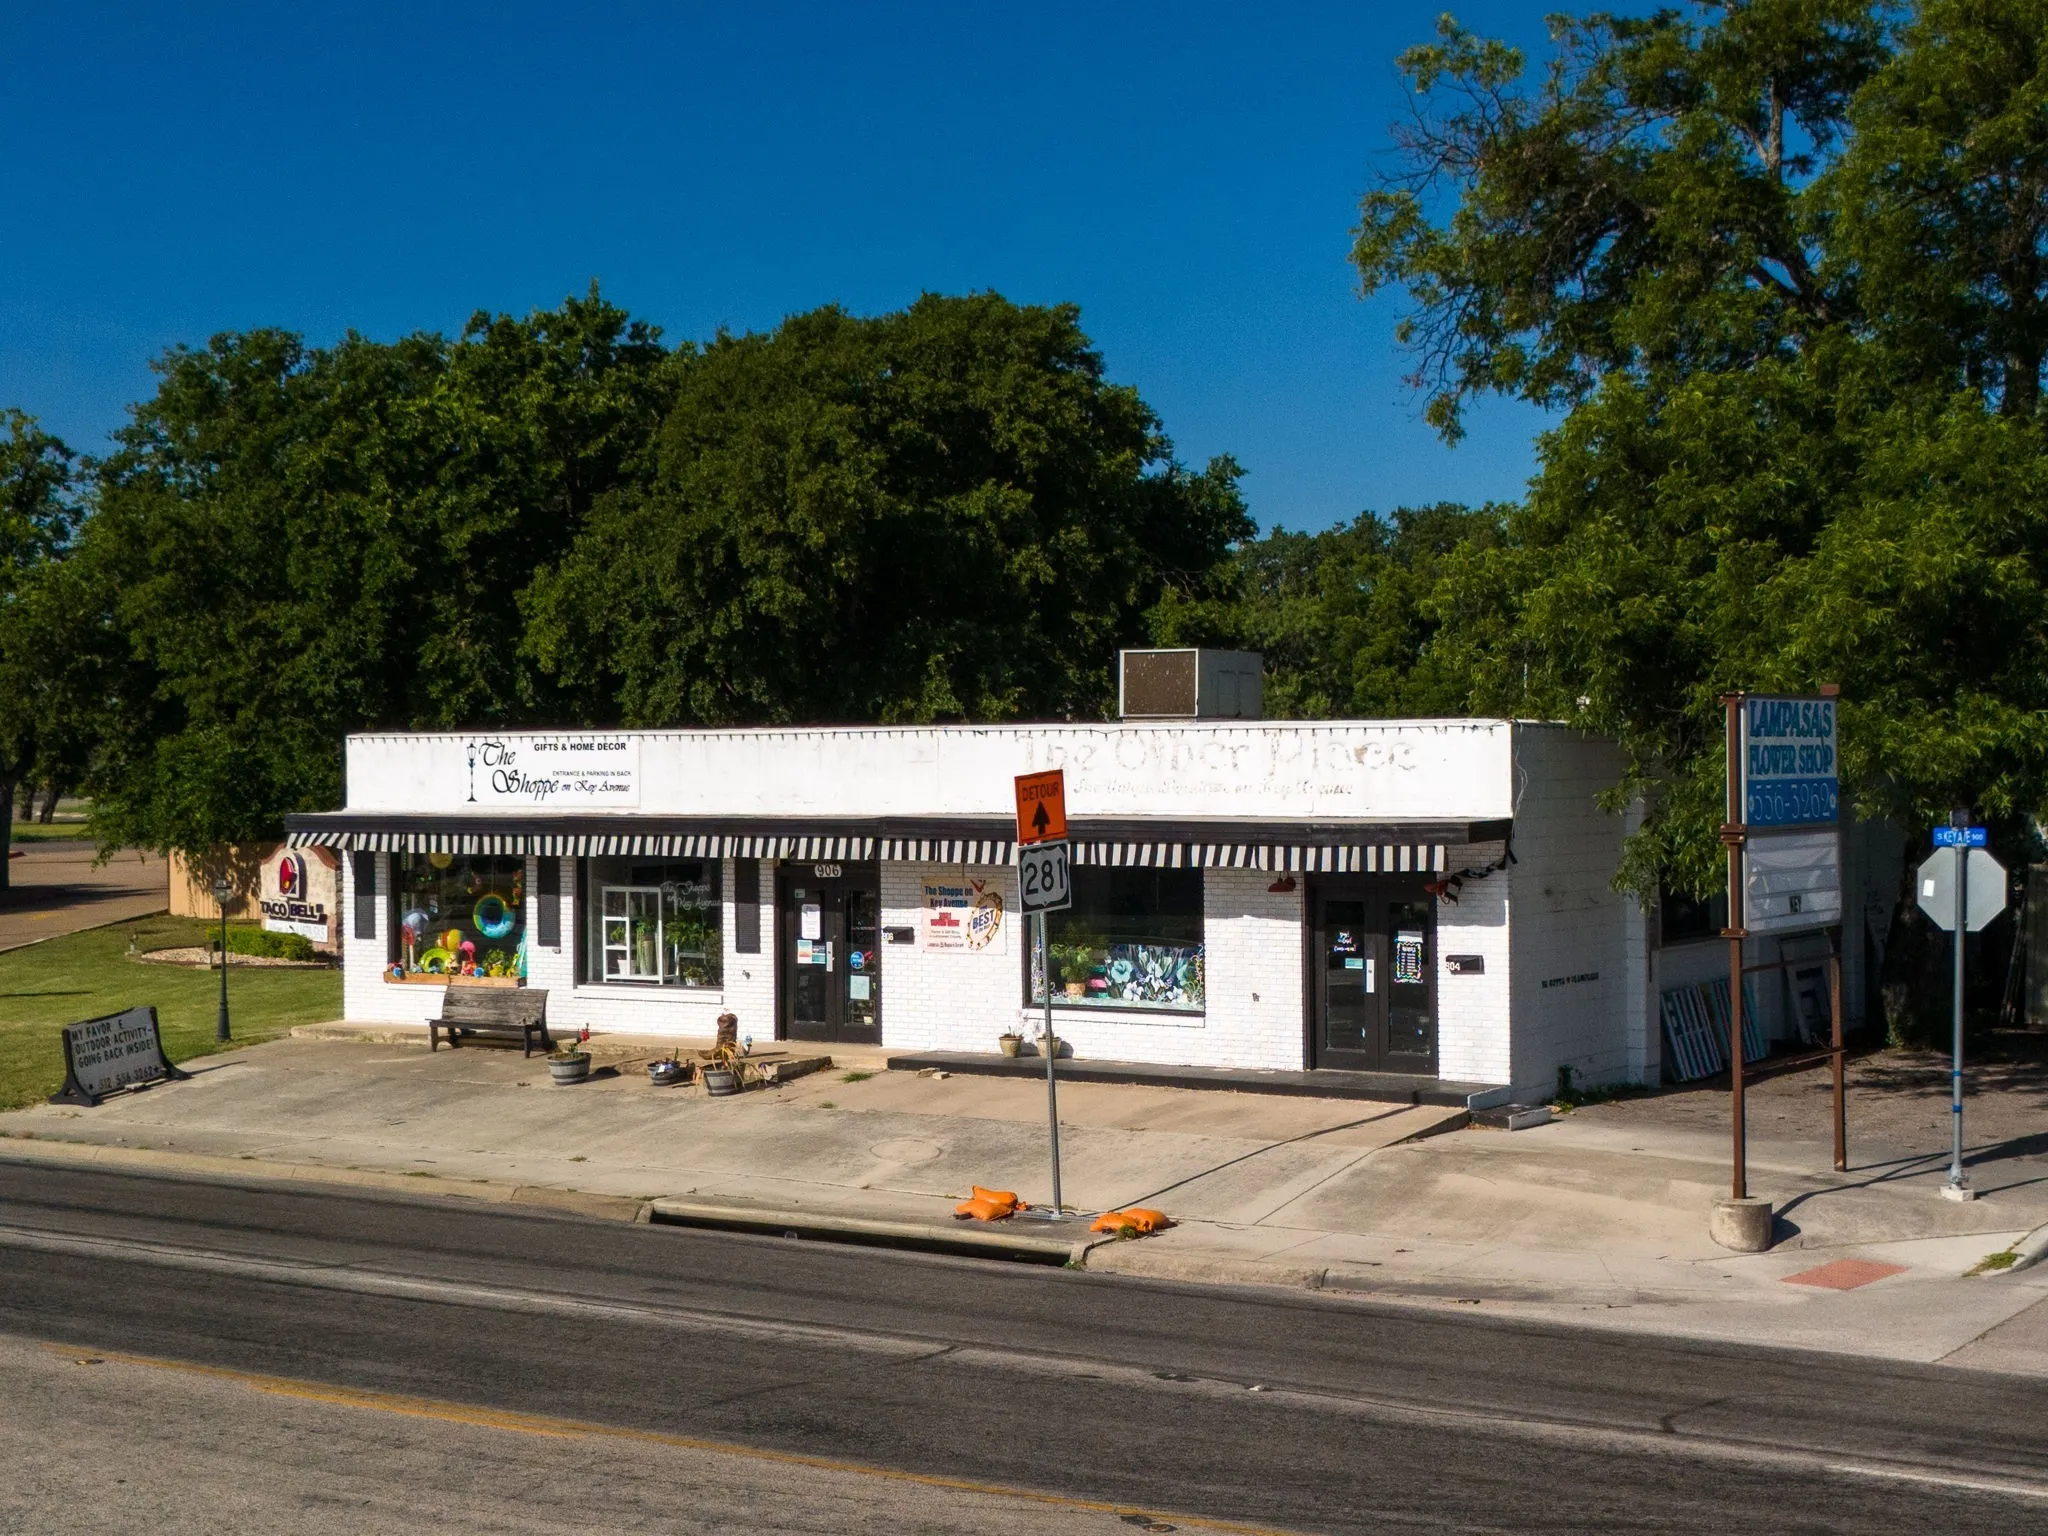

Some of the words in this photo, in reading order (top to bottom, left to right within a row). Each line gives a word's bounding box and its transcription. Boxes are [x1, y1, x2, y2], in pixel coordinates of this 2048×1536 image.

[1749, 700, 1832, 738] LAMPASAS
[479, 741, 516, 766] The
[534, 743, 559, 751] GIFTS
[561, 743, 567, 751] &
[570, 742, 595, 751] HOME
[597, 742, 626, 751] DECOR
[1749, 744, 1797, 775] FLOWER
[1799, 744, 1834, 774] SHOP
[492, 769, 559, 800] Shoppe
[561, 783, 571, 792] on
[574, 780, 596, 795] Key
[598, 780, 631, 792] Avenue
[1022, 782, 1059, 801] DETOUR
[1755, 783, 1831, 820] 556-3262
[817, 865, 839, 877] 906
[1024, 857, 1064, 896] 281
[925, 886, 937, 896] The
[938, 886, 963, 897] Shoppe
[965, 887, 973, 896] on
[260, 901, 287, 918] TACO
[290, 903, 317, 918] BELL
[930, 898, 943, 908] Key
[944, 898, 968, 908] Avenue
[972, 909, 994, 930] BEST
[72, 1029, 83, 1041] MY
[75, 1036, 111, 1054] OUTDOOR
[79, 1052, 102, 1068] GOING
[104, 1046, 124, 1061] BACK
